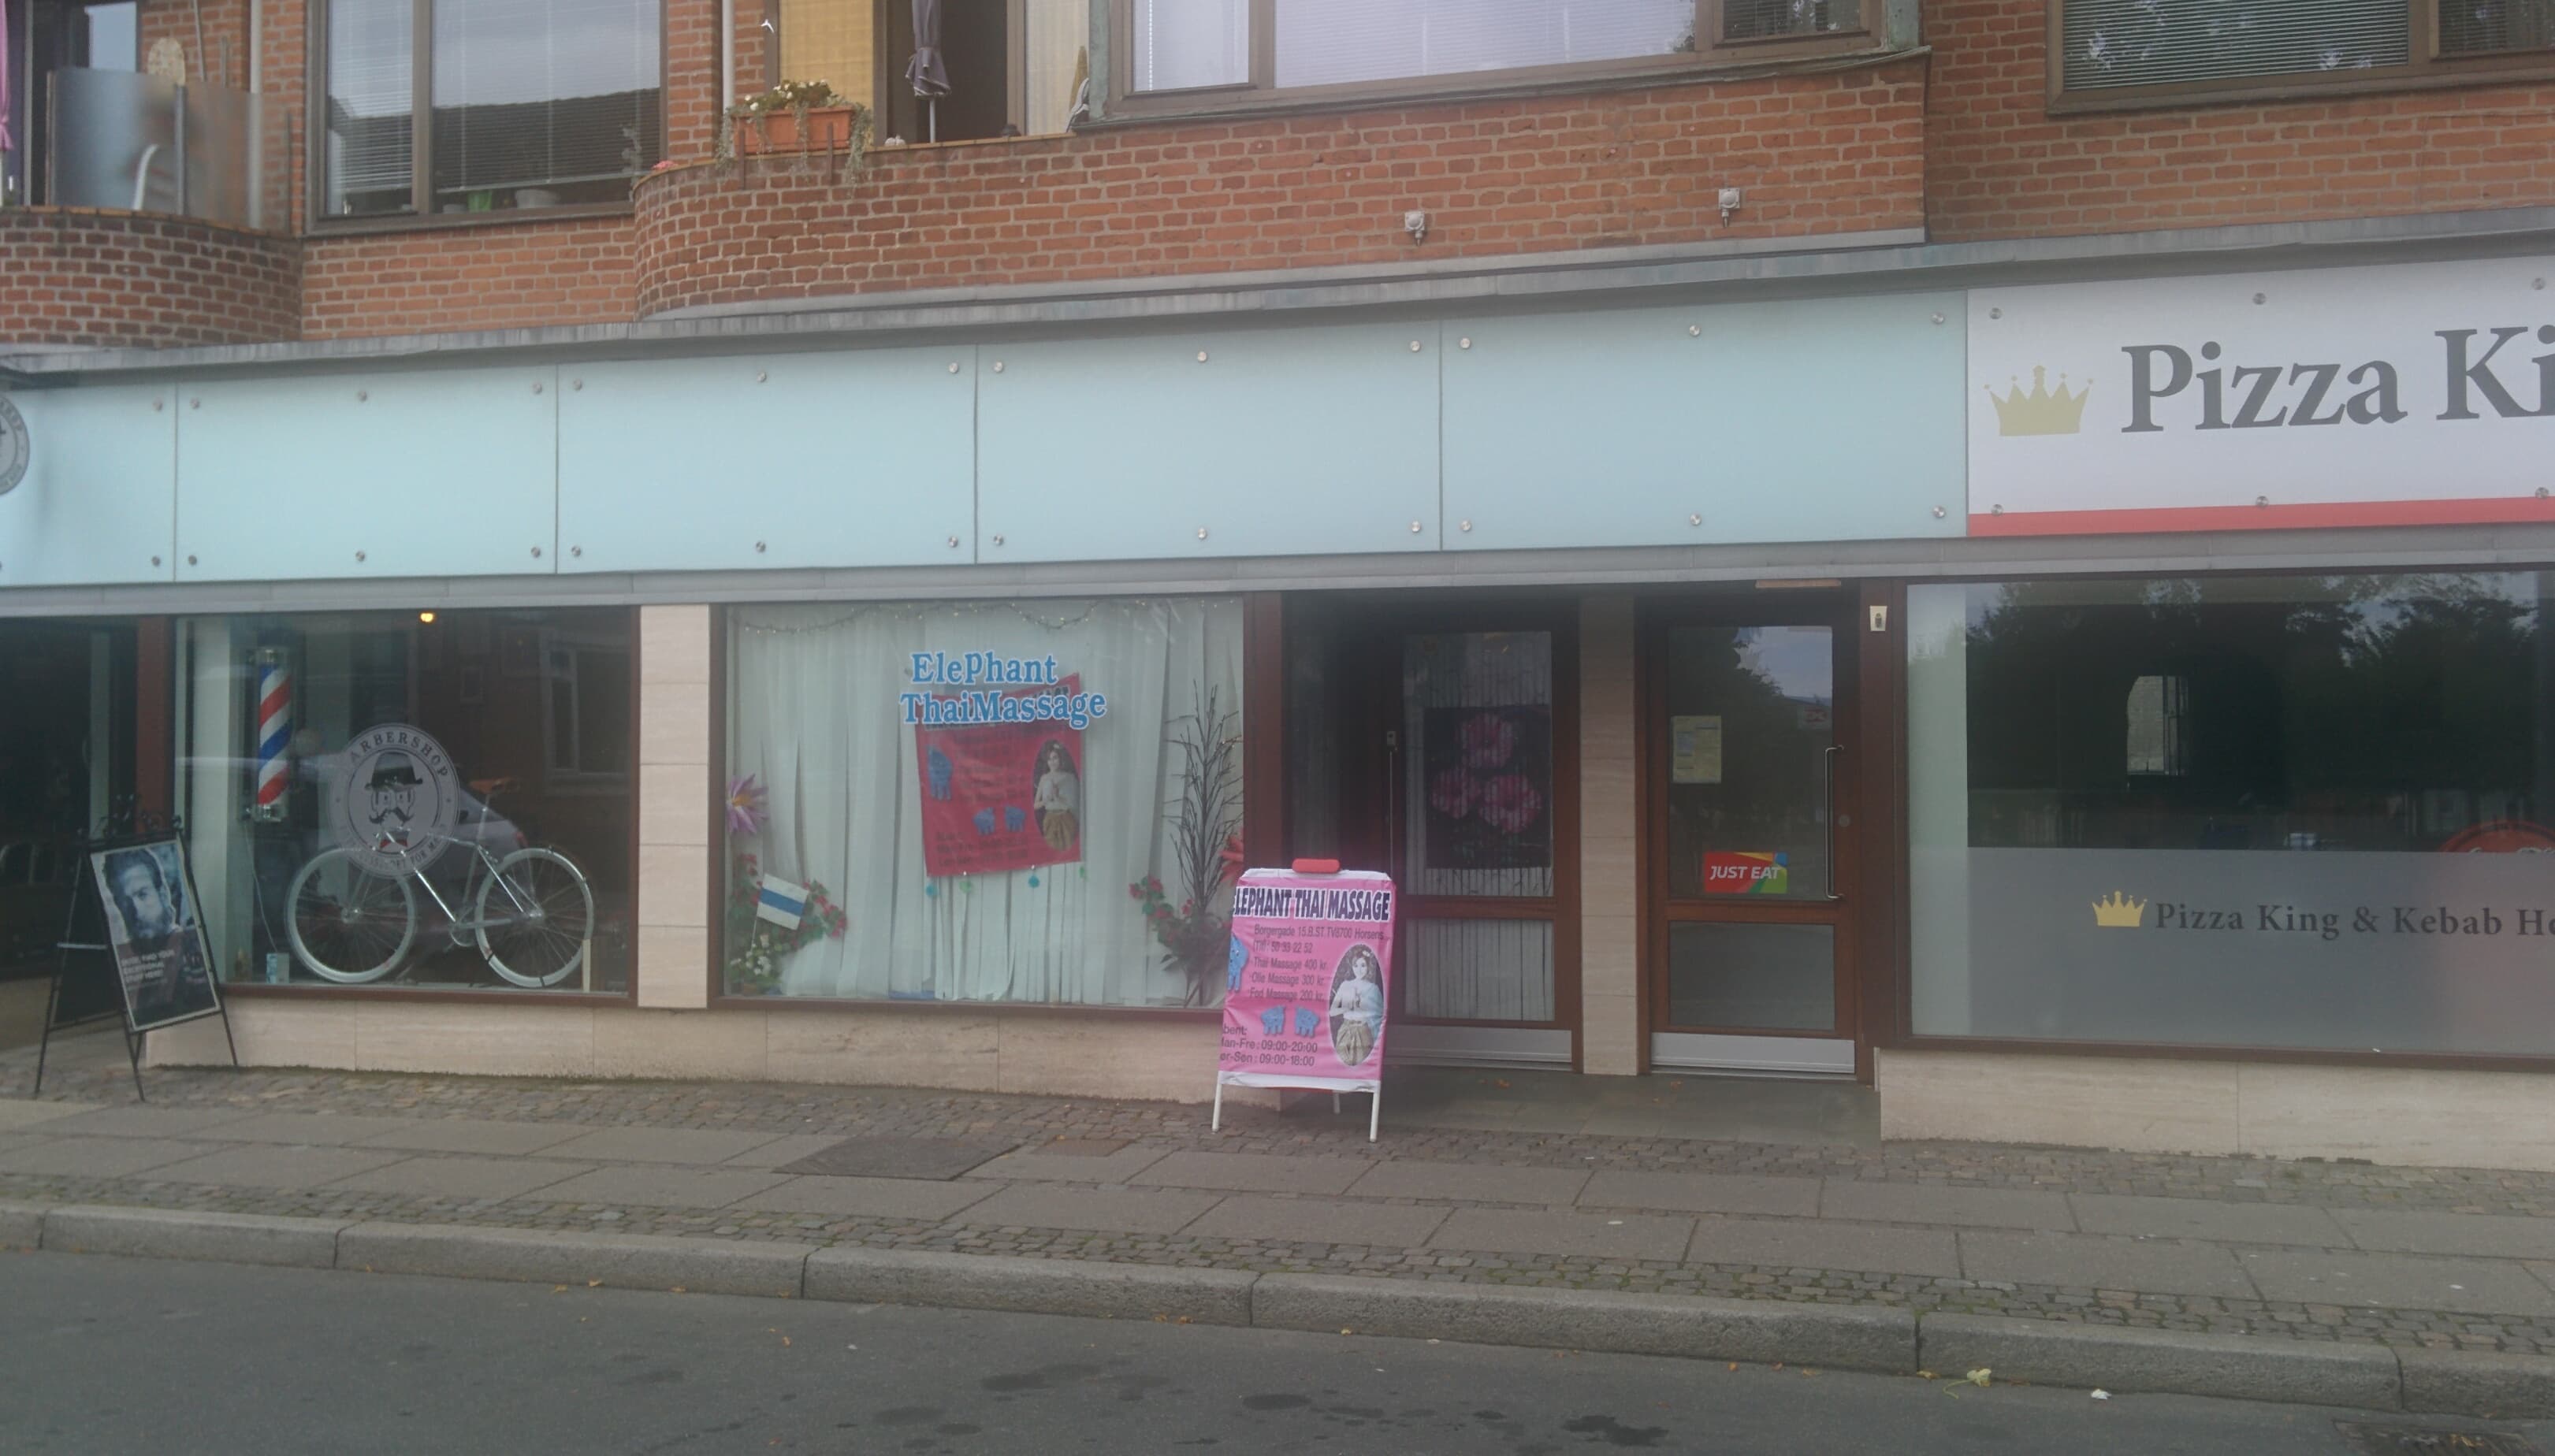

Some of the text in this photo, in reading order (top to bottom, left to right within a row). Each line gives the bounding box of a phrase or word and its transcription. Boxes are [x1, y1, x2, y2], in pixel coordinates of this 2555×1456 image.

[2121, 340, 2408, 433] Pizza
[345, 731, 448, 777] ARBERSHOP
[1709, 866, 1780, 880] JUST EAT
[1232, 887, 1390, 921] LEPHANT THAI MASSAGE
[2155, 903, 2244, 930] Pizza
[2256, 904, 2339, 940] King
[2352, 907, 2378, 933] &
[2393, 907, 2501, 935] Kebab
[1355, 929, 1385, 940] Horsens
[1271, 957, 1302, 971] Massage
[1304, 959, 1317, 970] 400
[1268, 973, 1300, 987] Massage
[1301, 975, 1315, 986] 300
[1266, 988, 1298, 1003] Massage
[1300, 990, 1313, 1001] 200
